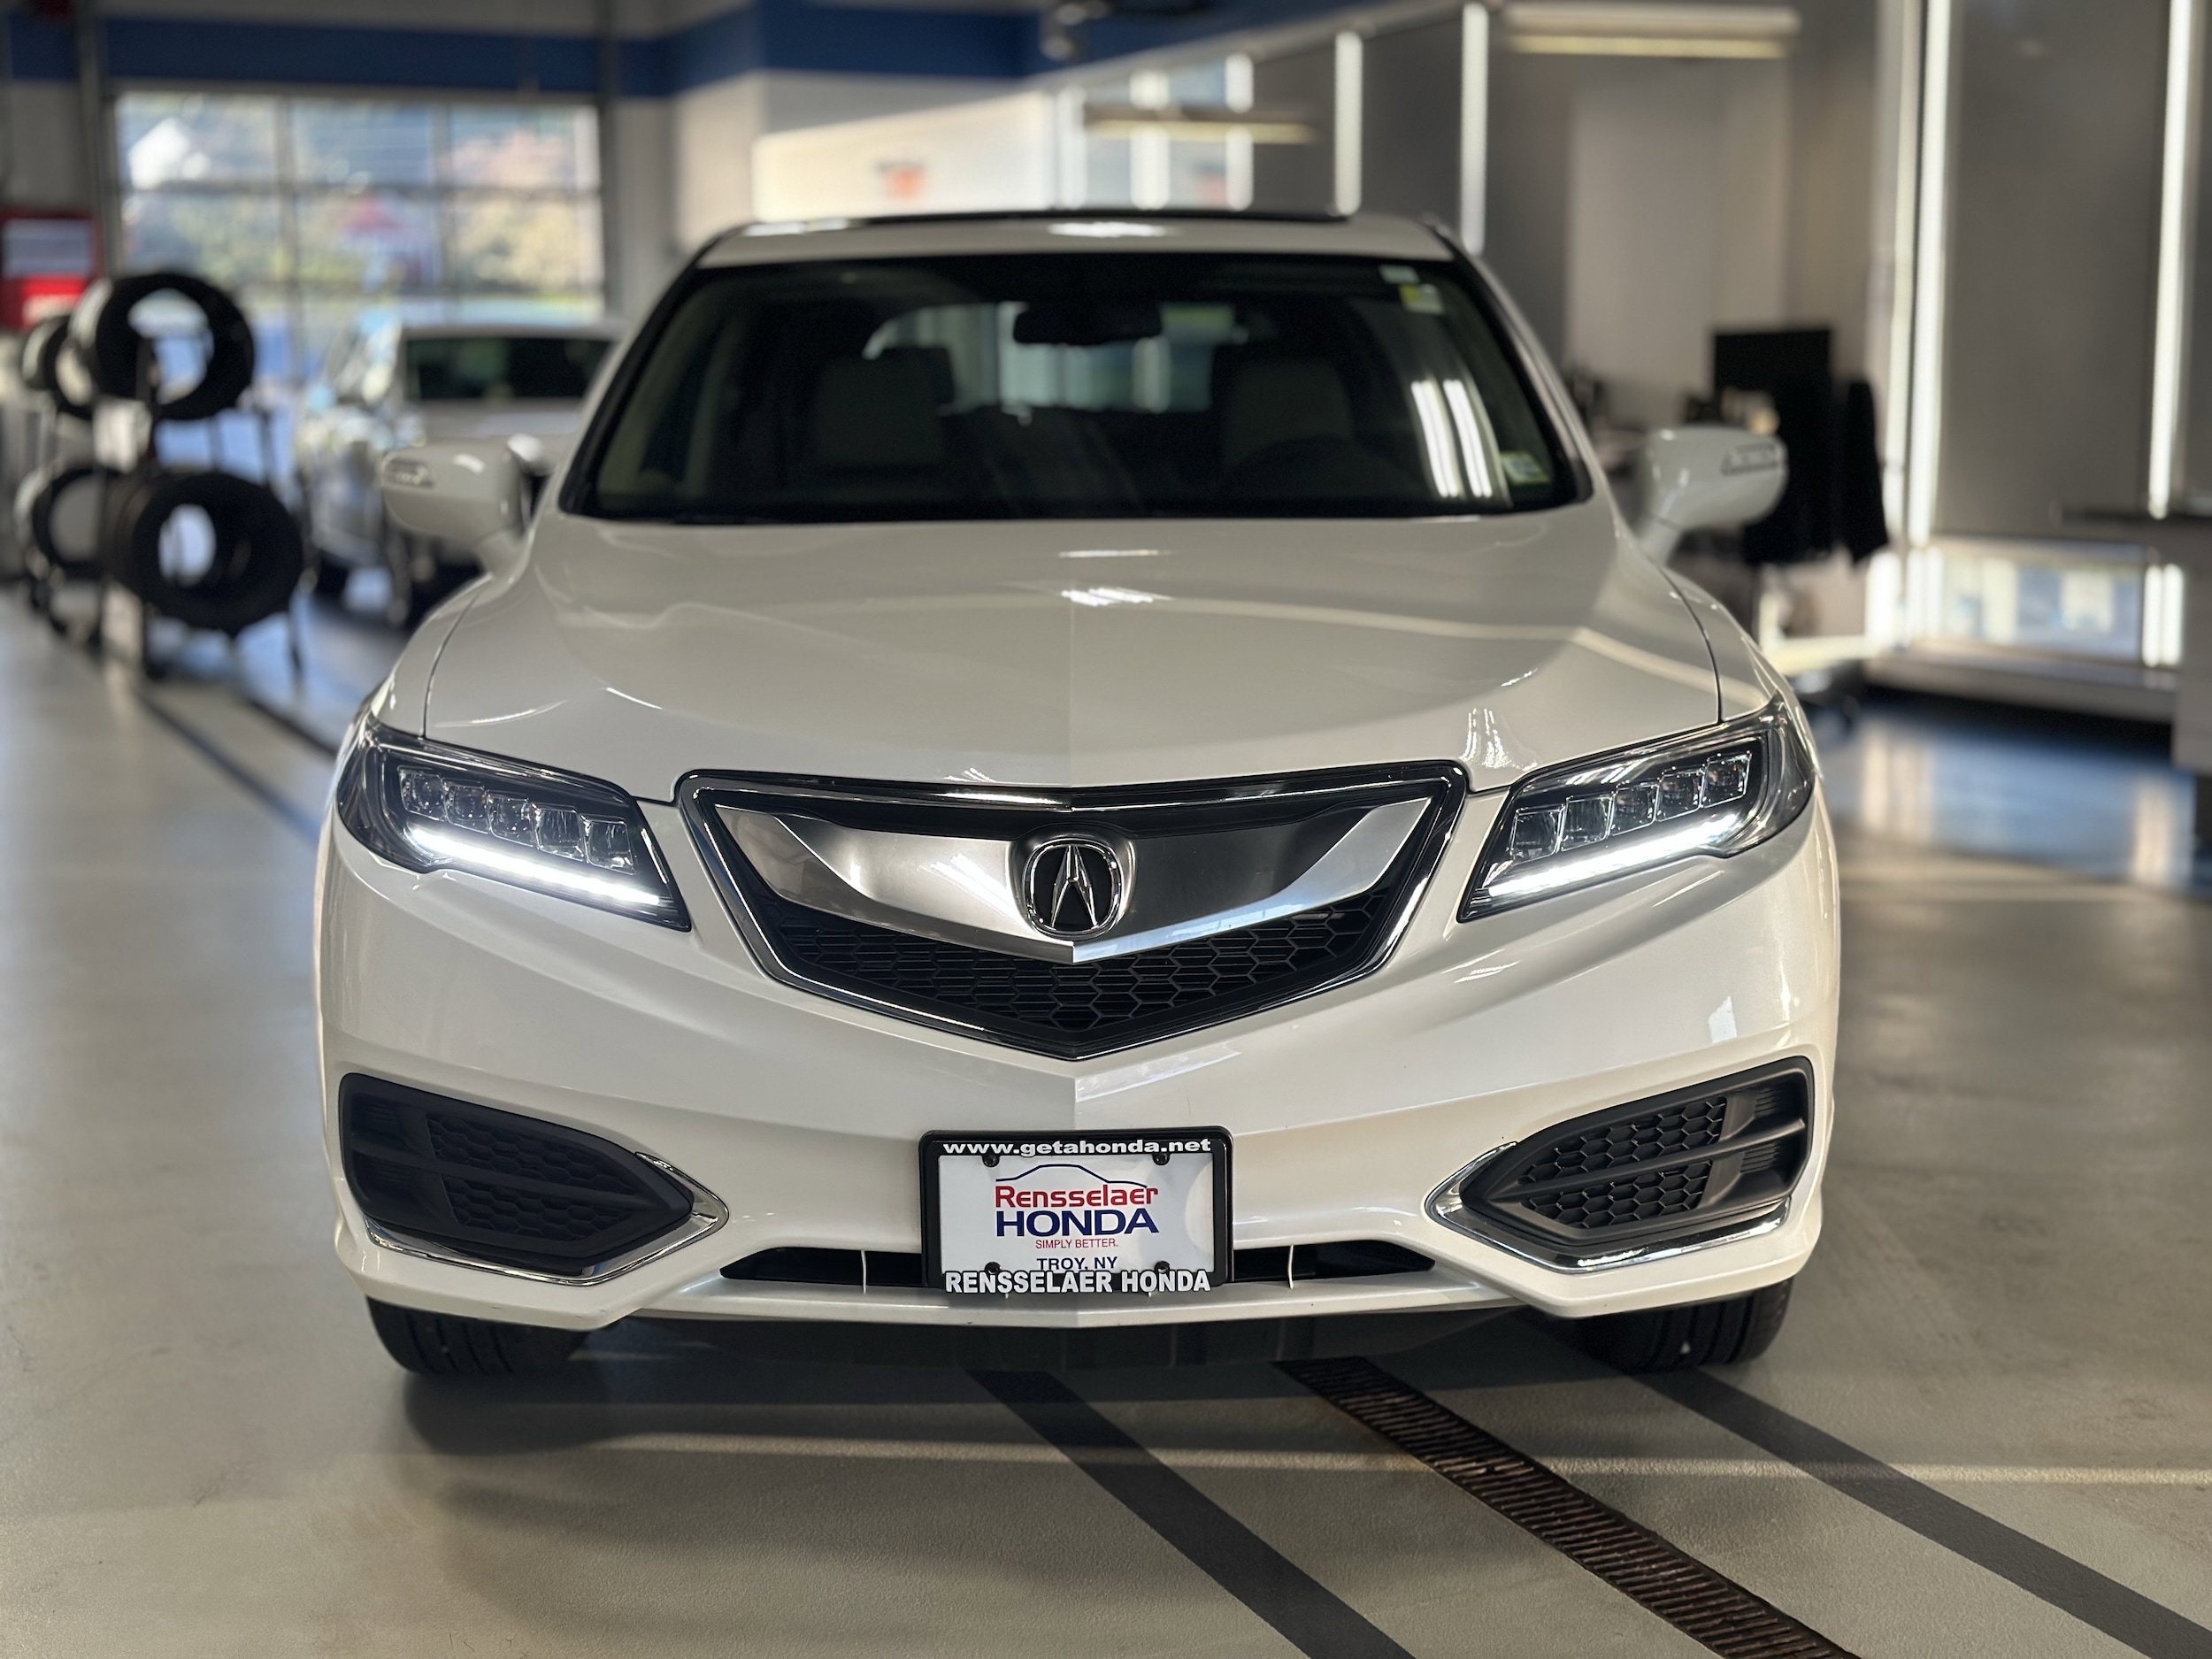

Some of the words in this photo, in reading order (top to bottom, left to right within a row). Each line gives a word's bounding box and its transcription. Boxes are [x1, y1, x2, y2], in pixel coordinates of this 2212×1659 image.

[943, 1140, 1210, 1156] www.getahonda.net
[995, 1185, 1158, 1208] Rensselaer
[996, 1209, 1159, 1236] HONDA
[1035, 1240, 1071, 1248] SIMPLY
[1075, 1239, 1118, 1248] BETTER.
[1094, 1256, 1118, 1269] NY
[945, 1271, 1112, 1294] RENSSELAER
[1121, 1271, 1211, 1293] HONDA
